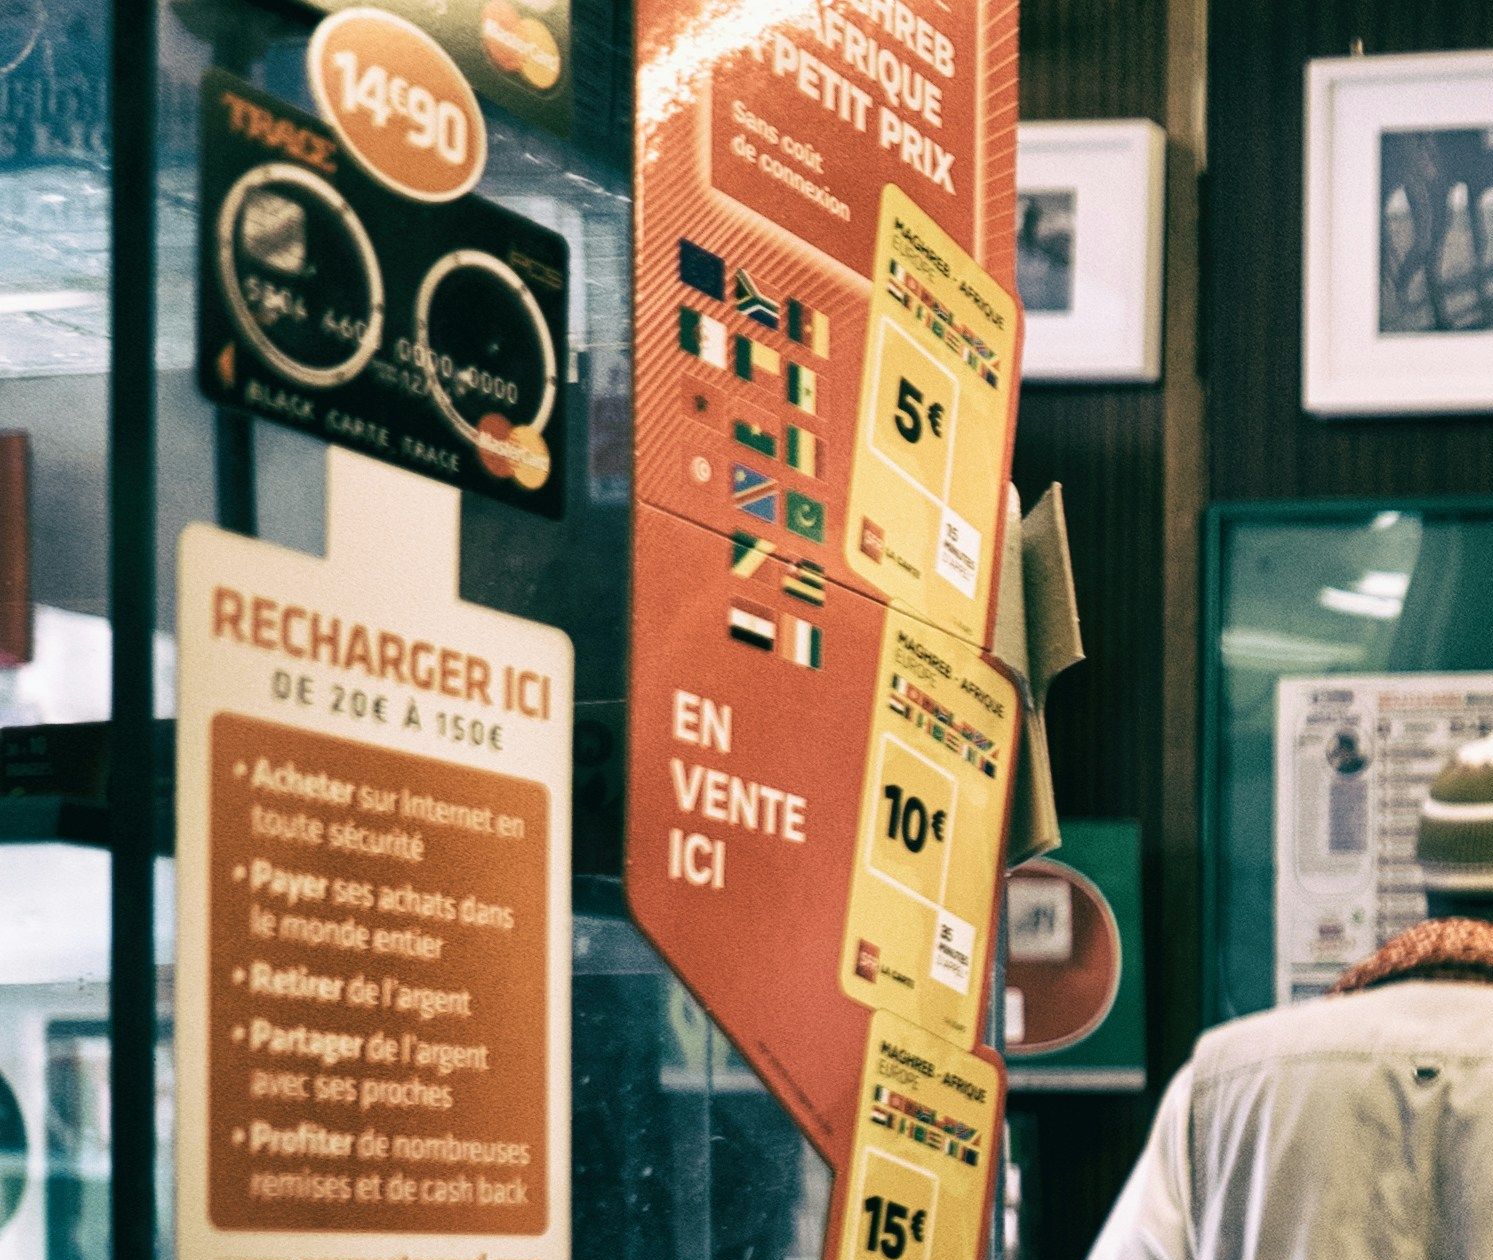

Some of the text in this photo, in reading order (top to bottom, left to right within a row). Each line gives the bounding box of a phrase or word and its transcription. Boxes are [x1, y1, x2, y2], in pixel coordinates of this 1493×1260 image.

[222, 93, 338, 174] TRACE
[731, 100, 826, 175] Sans coût
[769, 30, 957, 196] PETIT PRIX
[731, 134, 852, 223] de connexion
[326, 410, 392, 448] CARTE
[402, 437, 461, 473] TRACE
[211, 584, 554, 722] RECHARGER ICI
[272, 669, 506, 753] DE 20€ À 150€
[672, 688, 733, 755] EN
[960, 678, 1005, 720] AFRIQUE
[250, 758, 356, 809] Acheter
[360, 784, 399, 813] sur
[497, 812, 527, 840] en
[668, 757, 808, 845] VENTE
[883, 783, 948, 855] 10€
[250, 805, 427, 863] toute sécurité
[667, 827, 727, 890] ICI
[249, 860, 517, 931] Payer ses achats dans
[249, 905, 445, 962] le monde entier
[249, 963, 472, 1020] Retirer de l'argent
[249, 1018, 490, 1075] Partager de l'argent
[250, 1072, 455, 1112] avec ses proches
[942, 1072, 987, 1104] AFRIQUE
[250, 1121, 532, 1167] Profiter de nombreuses
[250, 1169, 530, 1207] remises et de cash back
